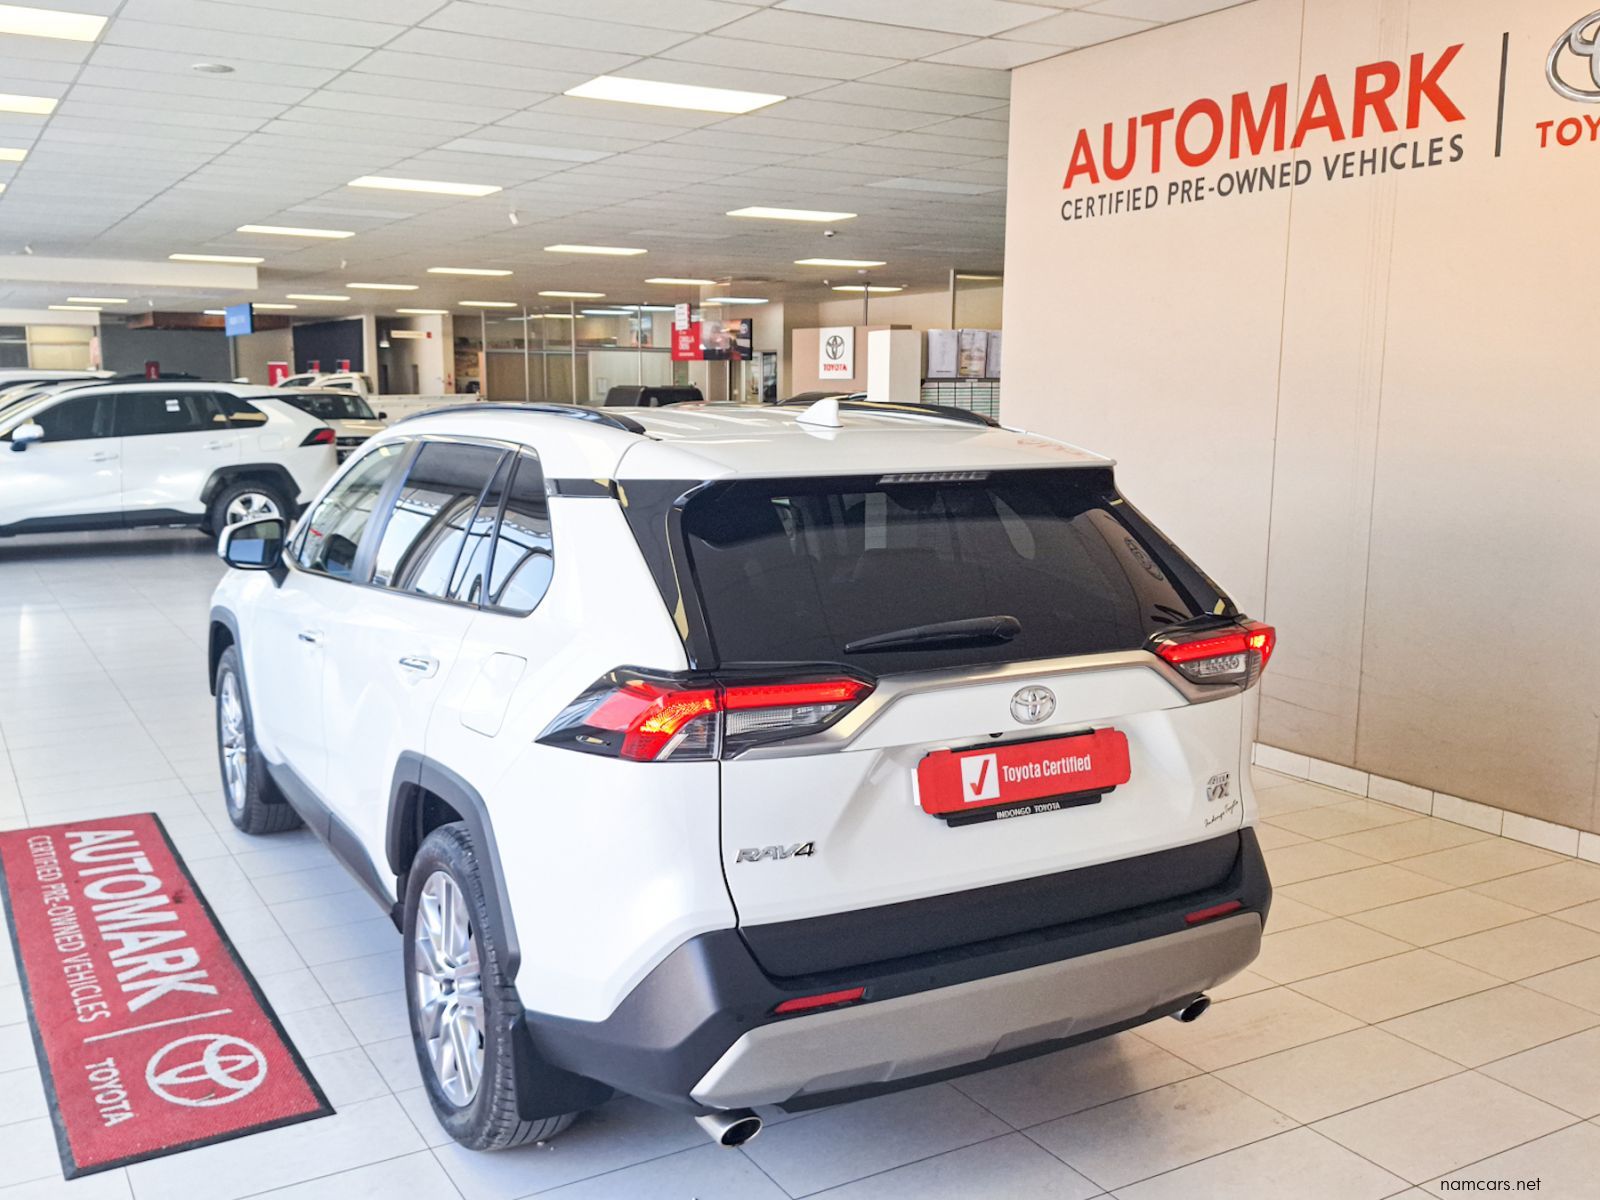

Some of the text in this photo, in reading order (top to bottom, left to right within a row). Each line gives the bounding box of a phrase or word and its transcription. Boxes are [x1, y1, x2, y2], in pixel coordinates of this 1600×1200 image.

[1062, 42, 1466, 190] AUTOMARK
[1061, 133, 1464, 221] CERTIFIED PRE-OWNED VEHICLES
[823, 363, 848, 372] TOYOTA
[1002, 754, 1092, 783] Toyota Certified
[996, 801, 1061, 819] INDONGO TOYOTA
[736, 841, 815, 864] RAV4
[27, 834, 112, 1024] CERTIFIED PRE-OWNED VEHICLES
[64, 829, 219, 1013] AUTOMARK
[84, 1057, 135, 1128] TOYOTA
